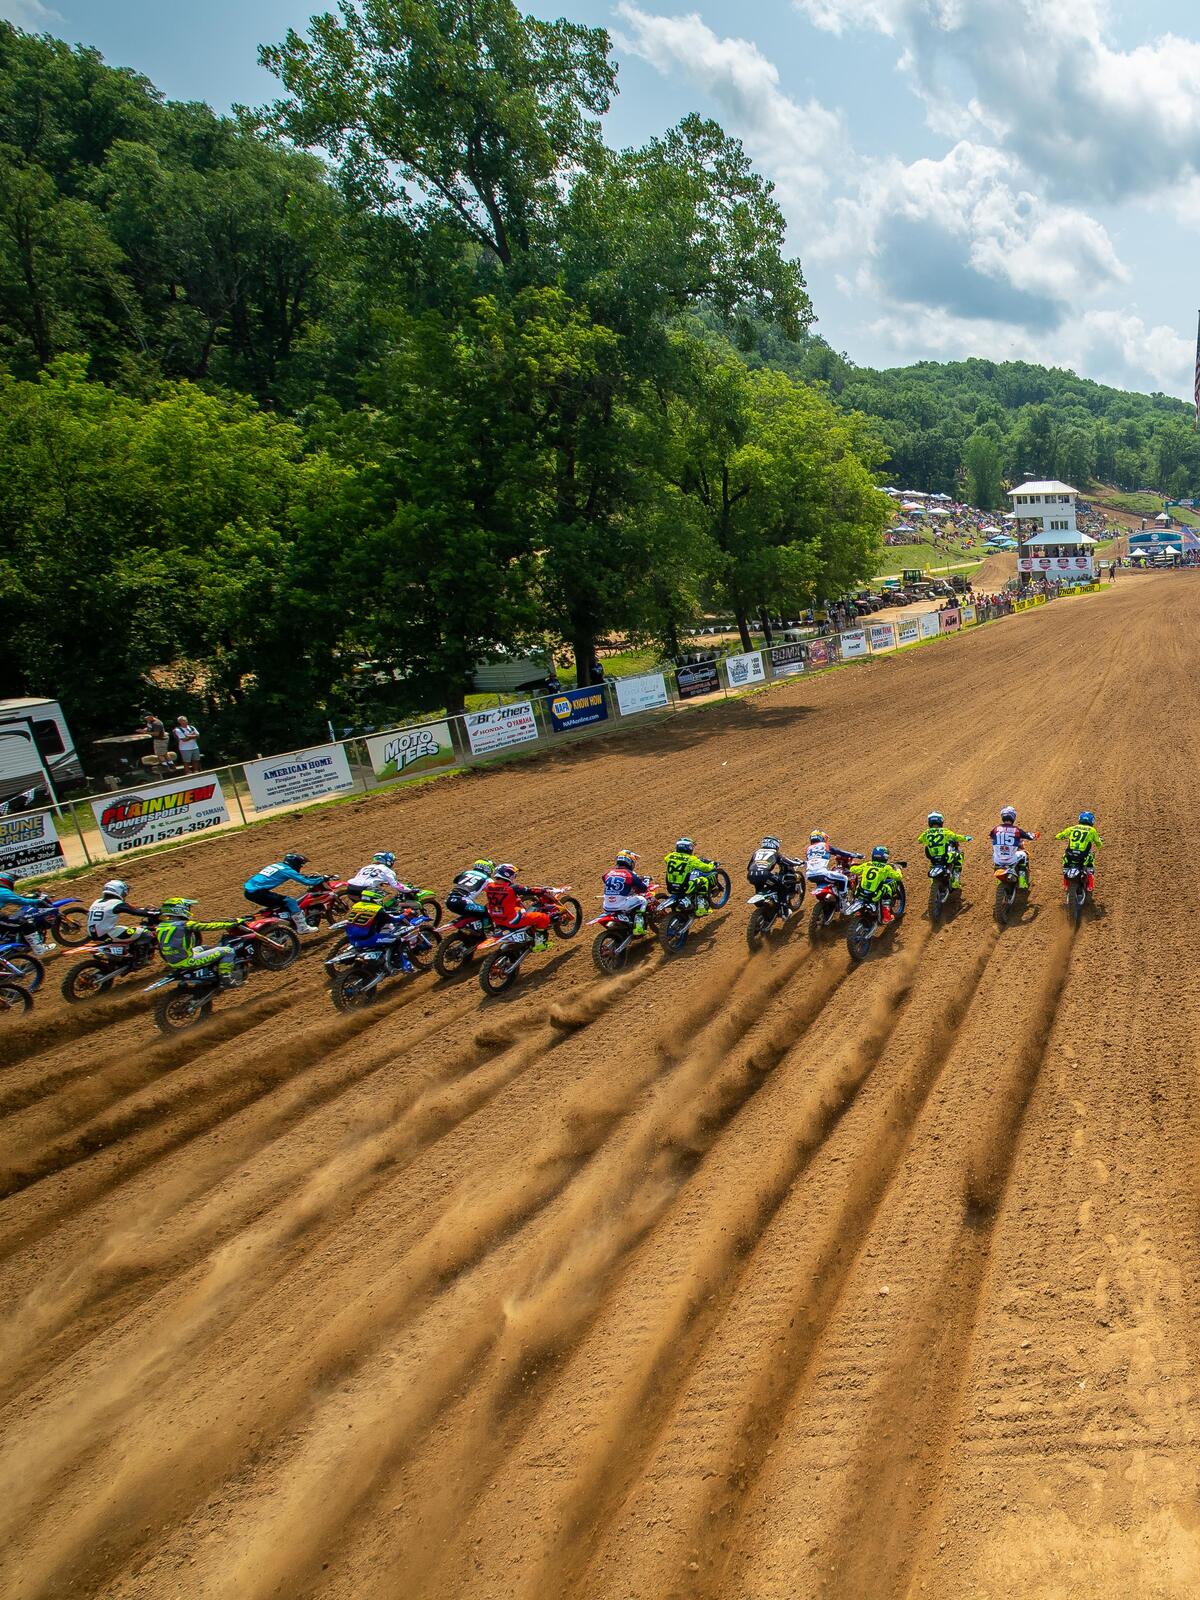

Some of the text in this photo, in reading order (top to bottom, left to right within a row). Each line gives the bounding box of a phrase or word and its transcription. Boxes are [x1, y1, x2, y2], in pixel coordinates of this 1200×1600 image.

[1060, 587, 1076, 595] THOR
[1080, 585, 1095, 593] THOR
[554, 701, 570, 714] NAPA
[572, 698, 589, 711] KNOW
[479, 725, 504, 736] HONDA
[385, 730, 434, 763] MOTO
[394, 740, 441, 772] TEES
[263, 757, 333, 780] AMERICAN HOME
[101, 783, 217, 826] PLAINVIEW
[201, 805, 226, 817] YAMAHA
[107, 804, 190, 832] POWERSPORTS
[117, 816, 221, 852] (507) 524-3520
[926, 833, 944, 848] 32
[996, 832, 1015, 846] 115
[1072, 829, 1089, 844] 91
[668, 860, 688, 876] 64
[866, 867, 879, 881] 6
[457, 873, 482, 887] 75
[471, 919, 483, 931] 75
[156, 925, 177, 944] 77
